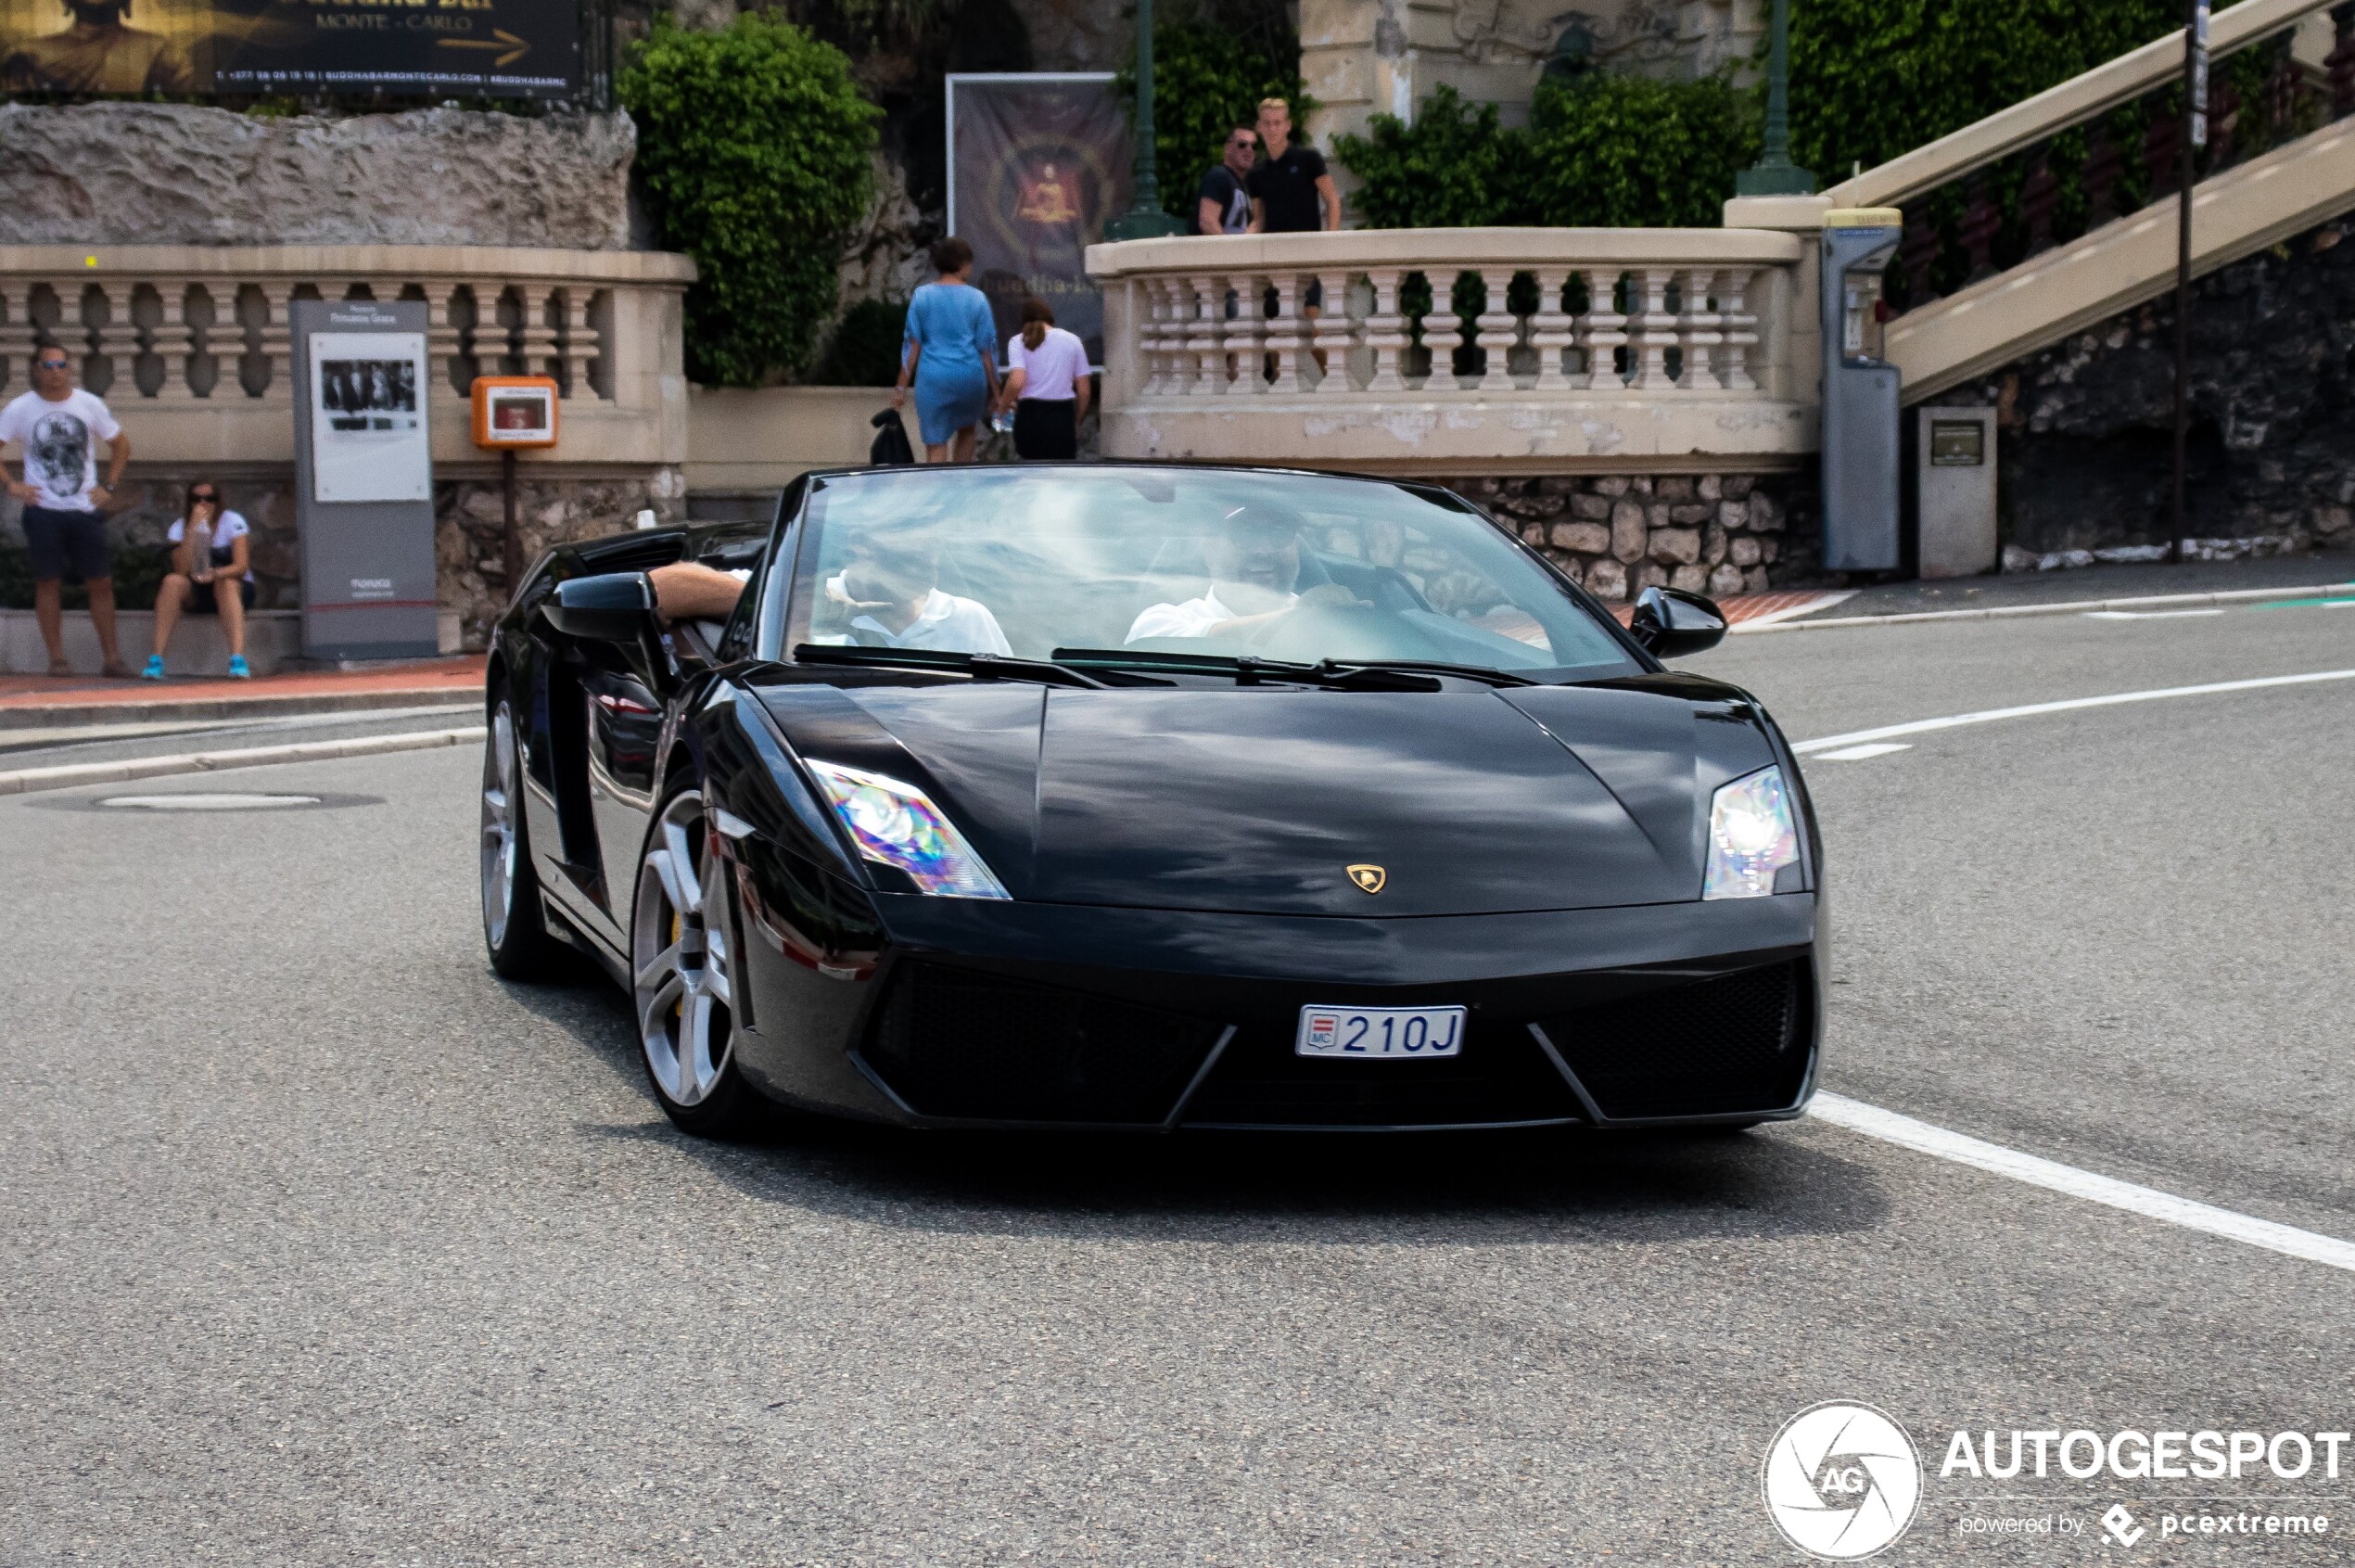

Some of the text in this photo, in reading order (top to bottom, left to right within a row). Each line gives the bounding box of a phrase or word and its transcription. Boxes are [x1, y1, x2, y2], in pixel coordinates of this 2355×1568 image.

[316, 14, 388, 31] MONTE
[405, 15, 473, 31] CARLO
[325, 71, 481, 82] BUDDHABARMONTECARLO.COM
[1311, 1015, 1458, 1052] MC 210J
